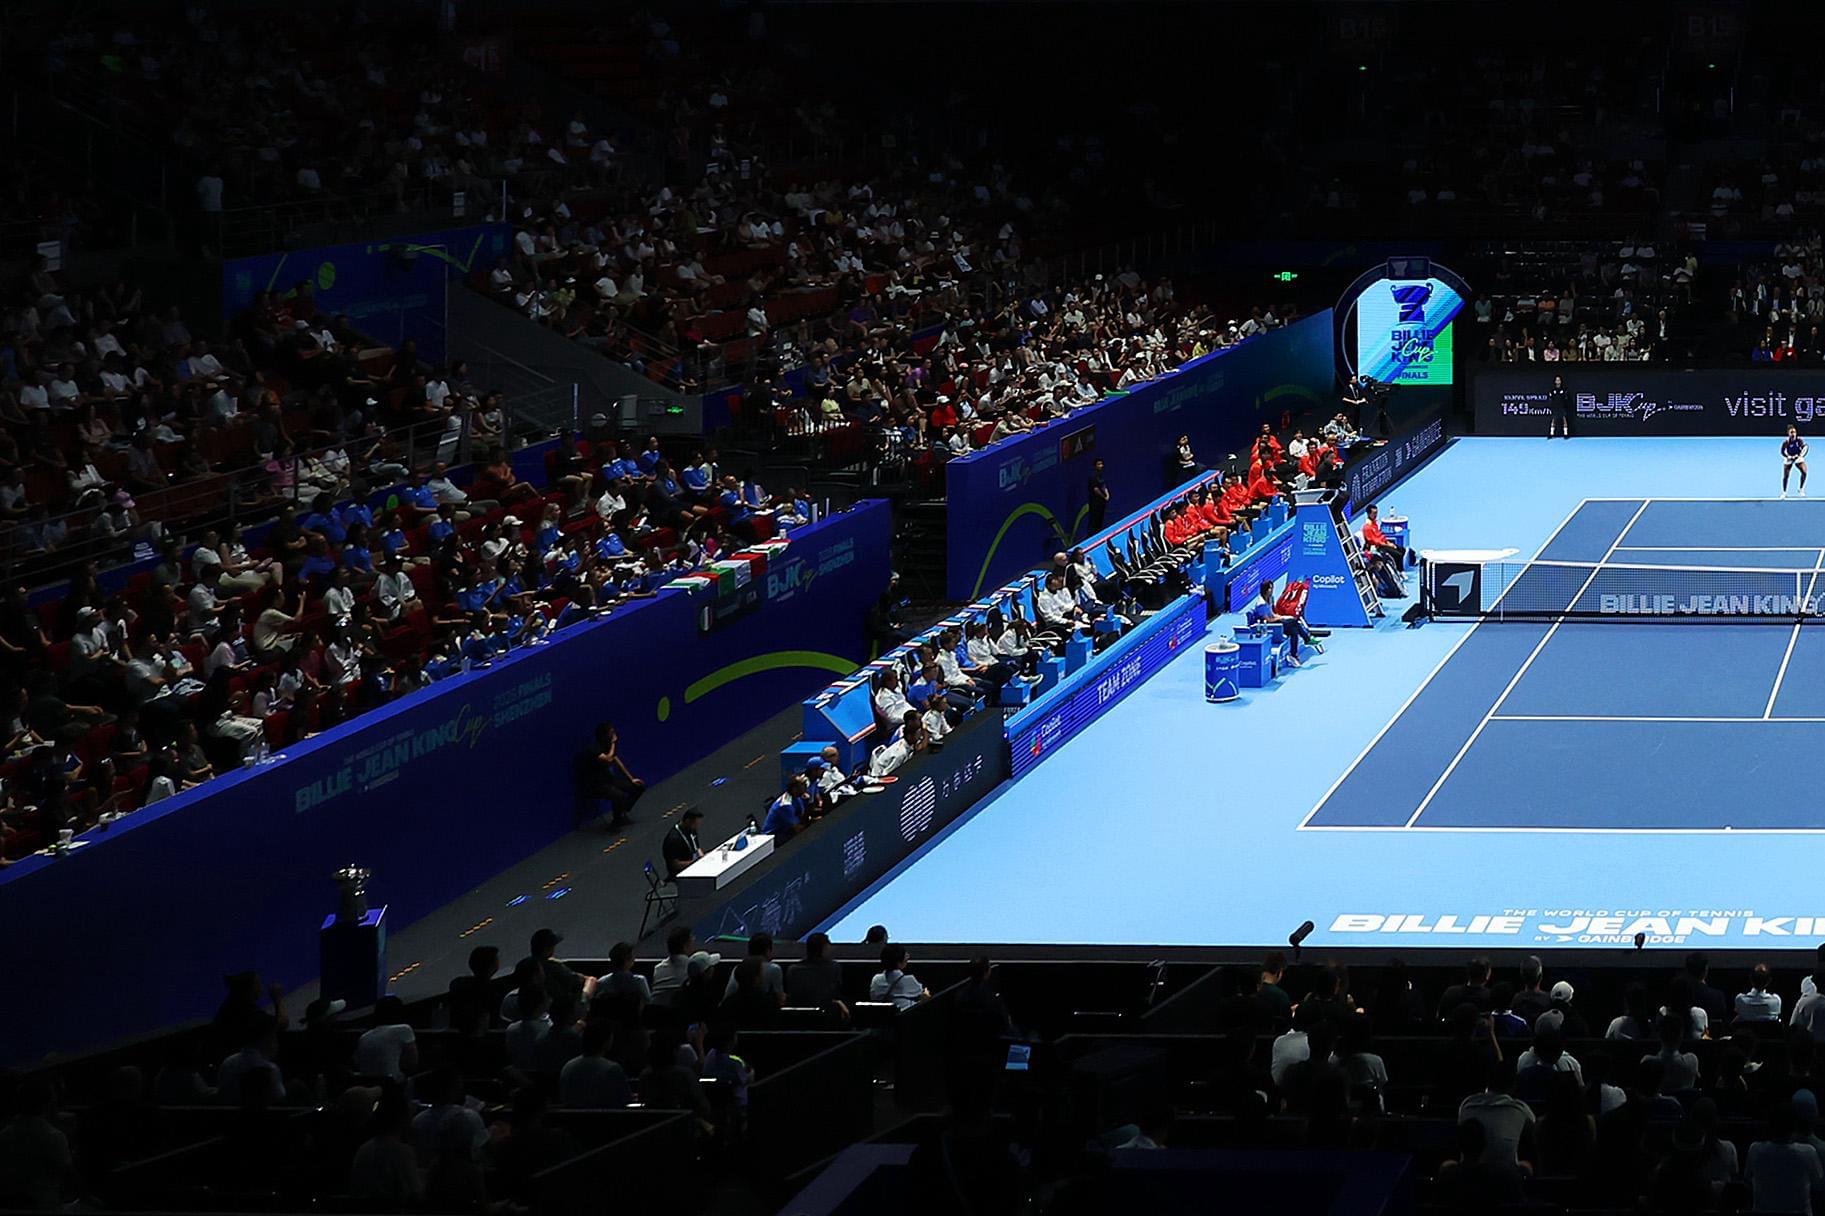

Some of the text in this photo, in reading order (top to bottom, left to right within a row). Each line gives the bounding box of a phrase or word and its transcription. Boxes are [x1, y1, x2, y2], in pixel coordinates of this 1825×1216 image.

[1576, 393, 1632, 412] BJK
[1724, 390, 1787, 417] visit
[767, 559, 804, 599] BJK
[1312, 575, 1345, 585] Copilot
[1600, 594, 1675, 614] BILLIE
[1679, 594, 1750, 614] JEAN
[1754, 594, 1817, 614] KING
[295, 764, 352, 813] BILLIE
[357, 737, 410, 784] JEAN
[1329, 914, 1531, 934] BILLIE
[1538, 917, 1729, 935] JEAN
[1577, 935, 1687, 944] GAINBIDGE
